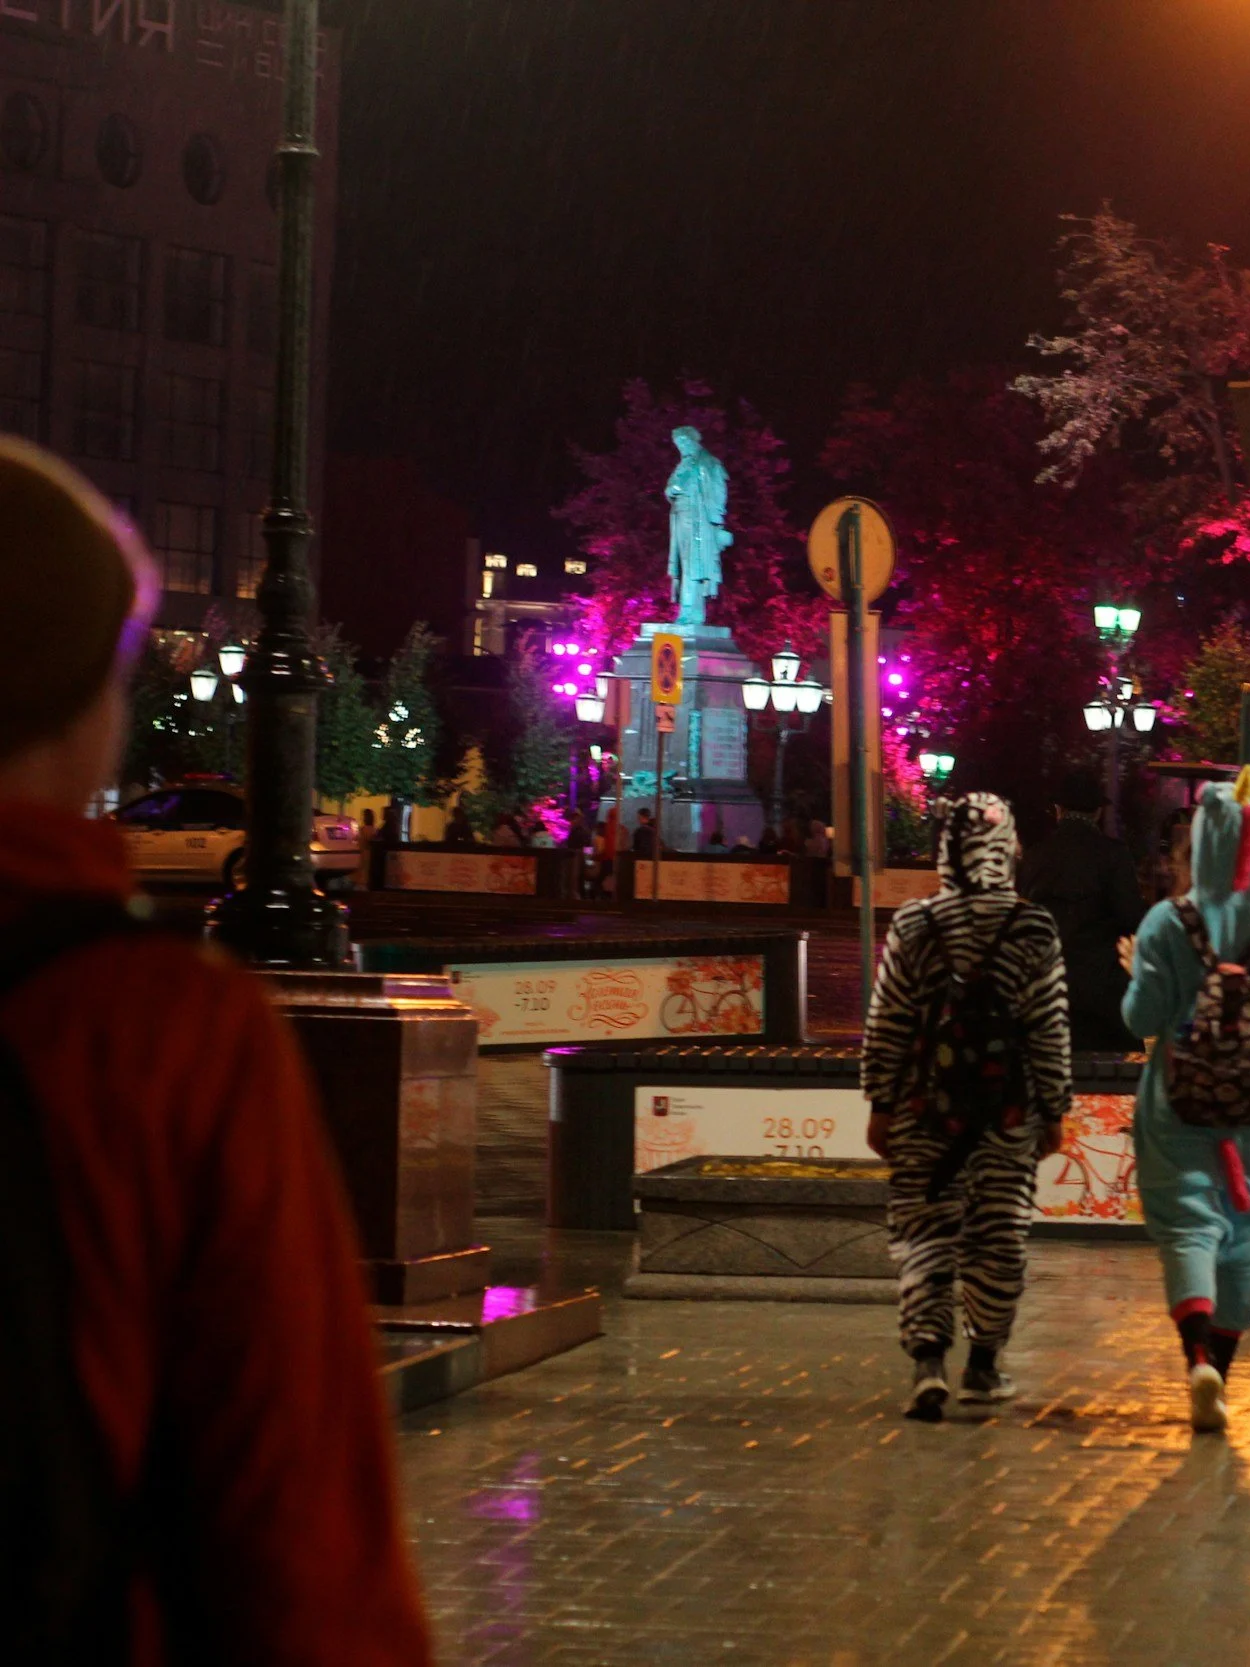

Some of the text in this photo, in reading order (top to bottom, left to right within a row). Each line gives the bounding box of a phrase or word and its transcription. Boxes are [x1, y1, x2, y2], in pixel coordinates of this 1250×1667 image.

[0, 0, 175, 52] ИЯ
[514, 980, 557, 995] 28.09
[763, 1117, 835, 1139] 28.09
[764, 1145, 825, 1158] -710
